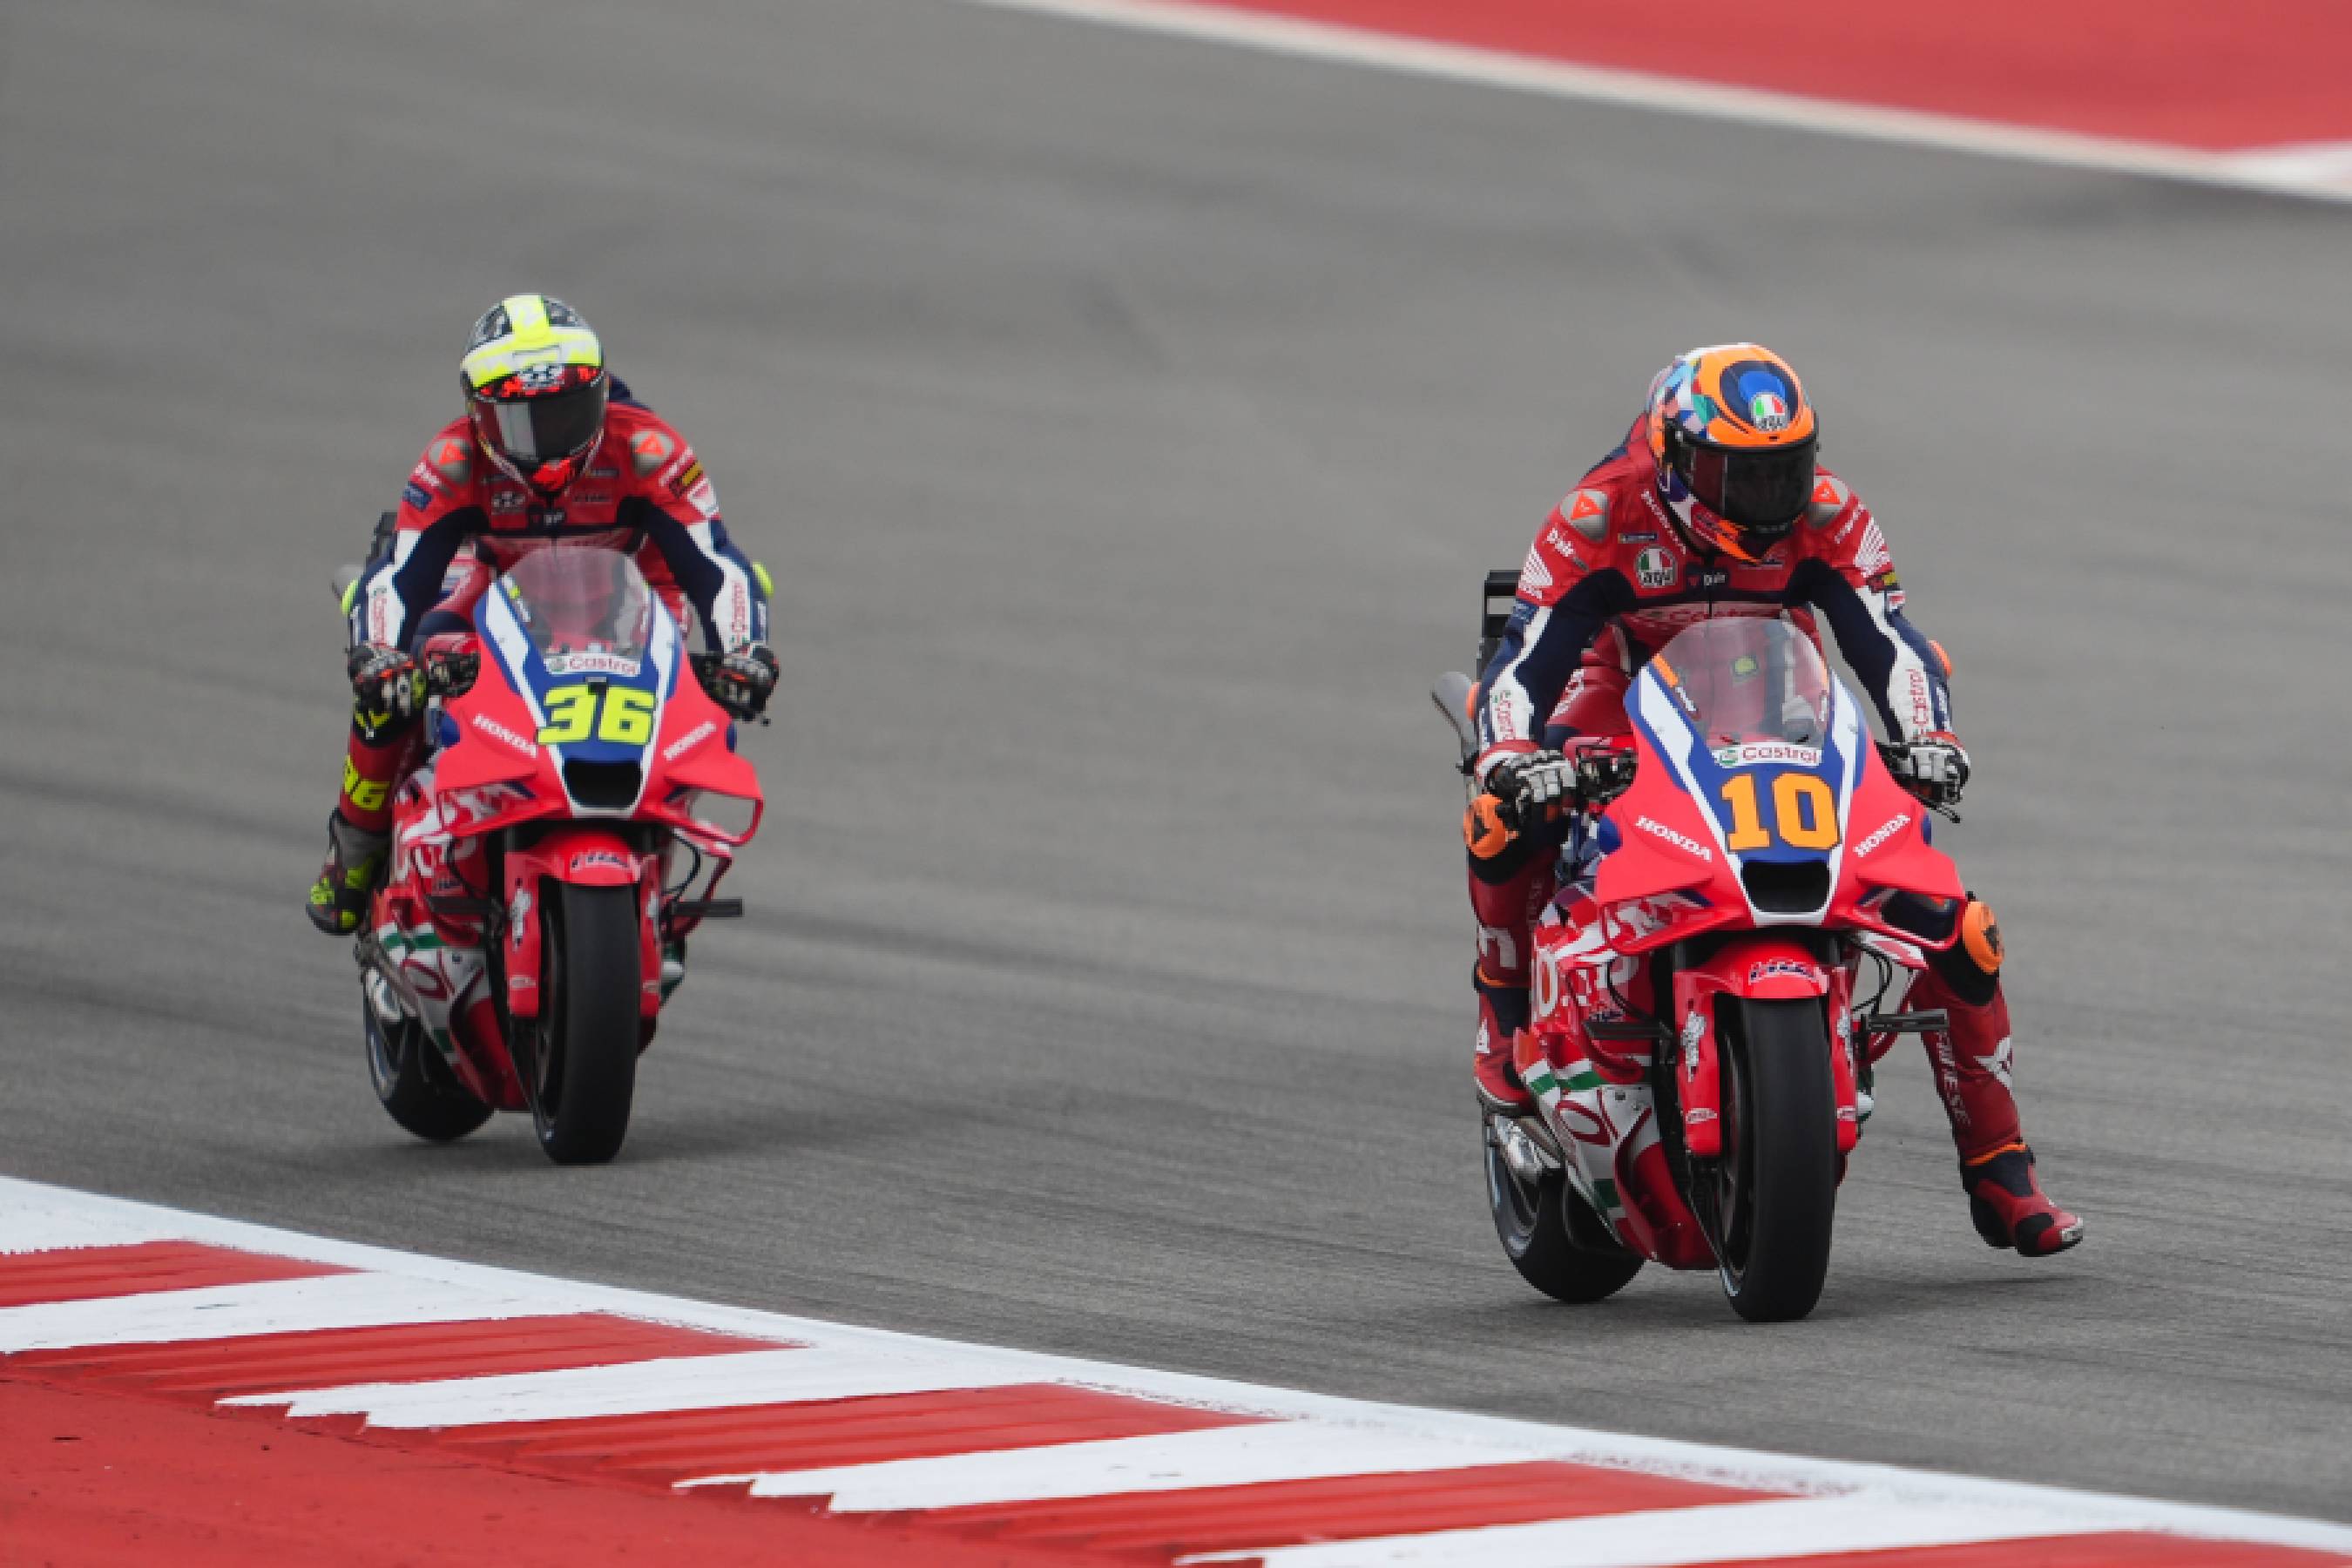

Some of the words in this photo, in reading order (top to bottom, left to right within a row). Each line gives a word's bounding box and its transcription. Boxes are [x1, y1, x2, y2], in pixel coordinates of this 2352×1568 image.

[568, 655, 639, 675] Castrol
[537, 684, 654, 746] 36
[1905, 667, 1929, 726] Castrol
[472, 712, 537, 760] HONDA
[662, 720, 717, 760] HONDA
[1742, 746, 1817, 763] Castrol
[1720, 772, 1841, 850] 10
[1852, 812, 1911, 858] HONDA
[1635, 814, 1713, 863] HONDA
